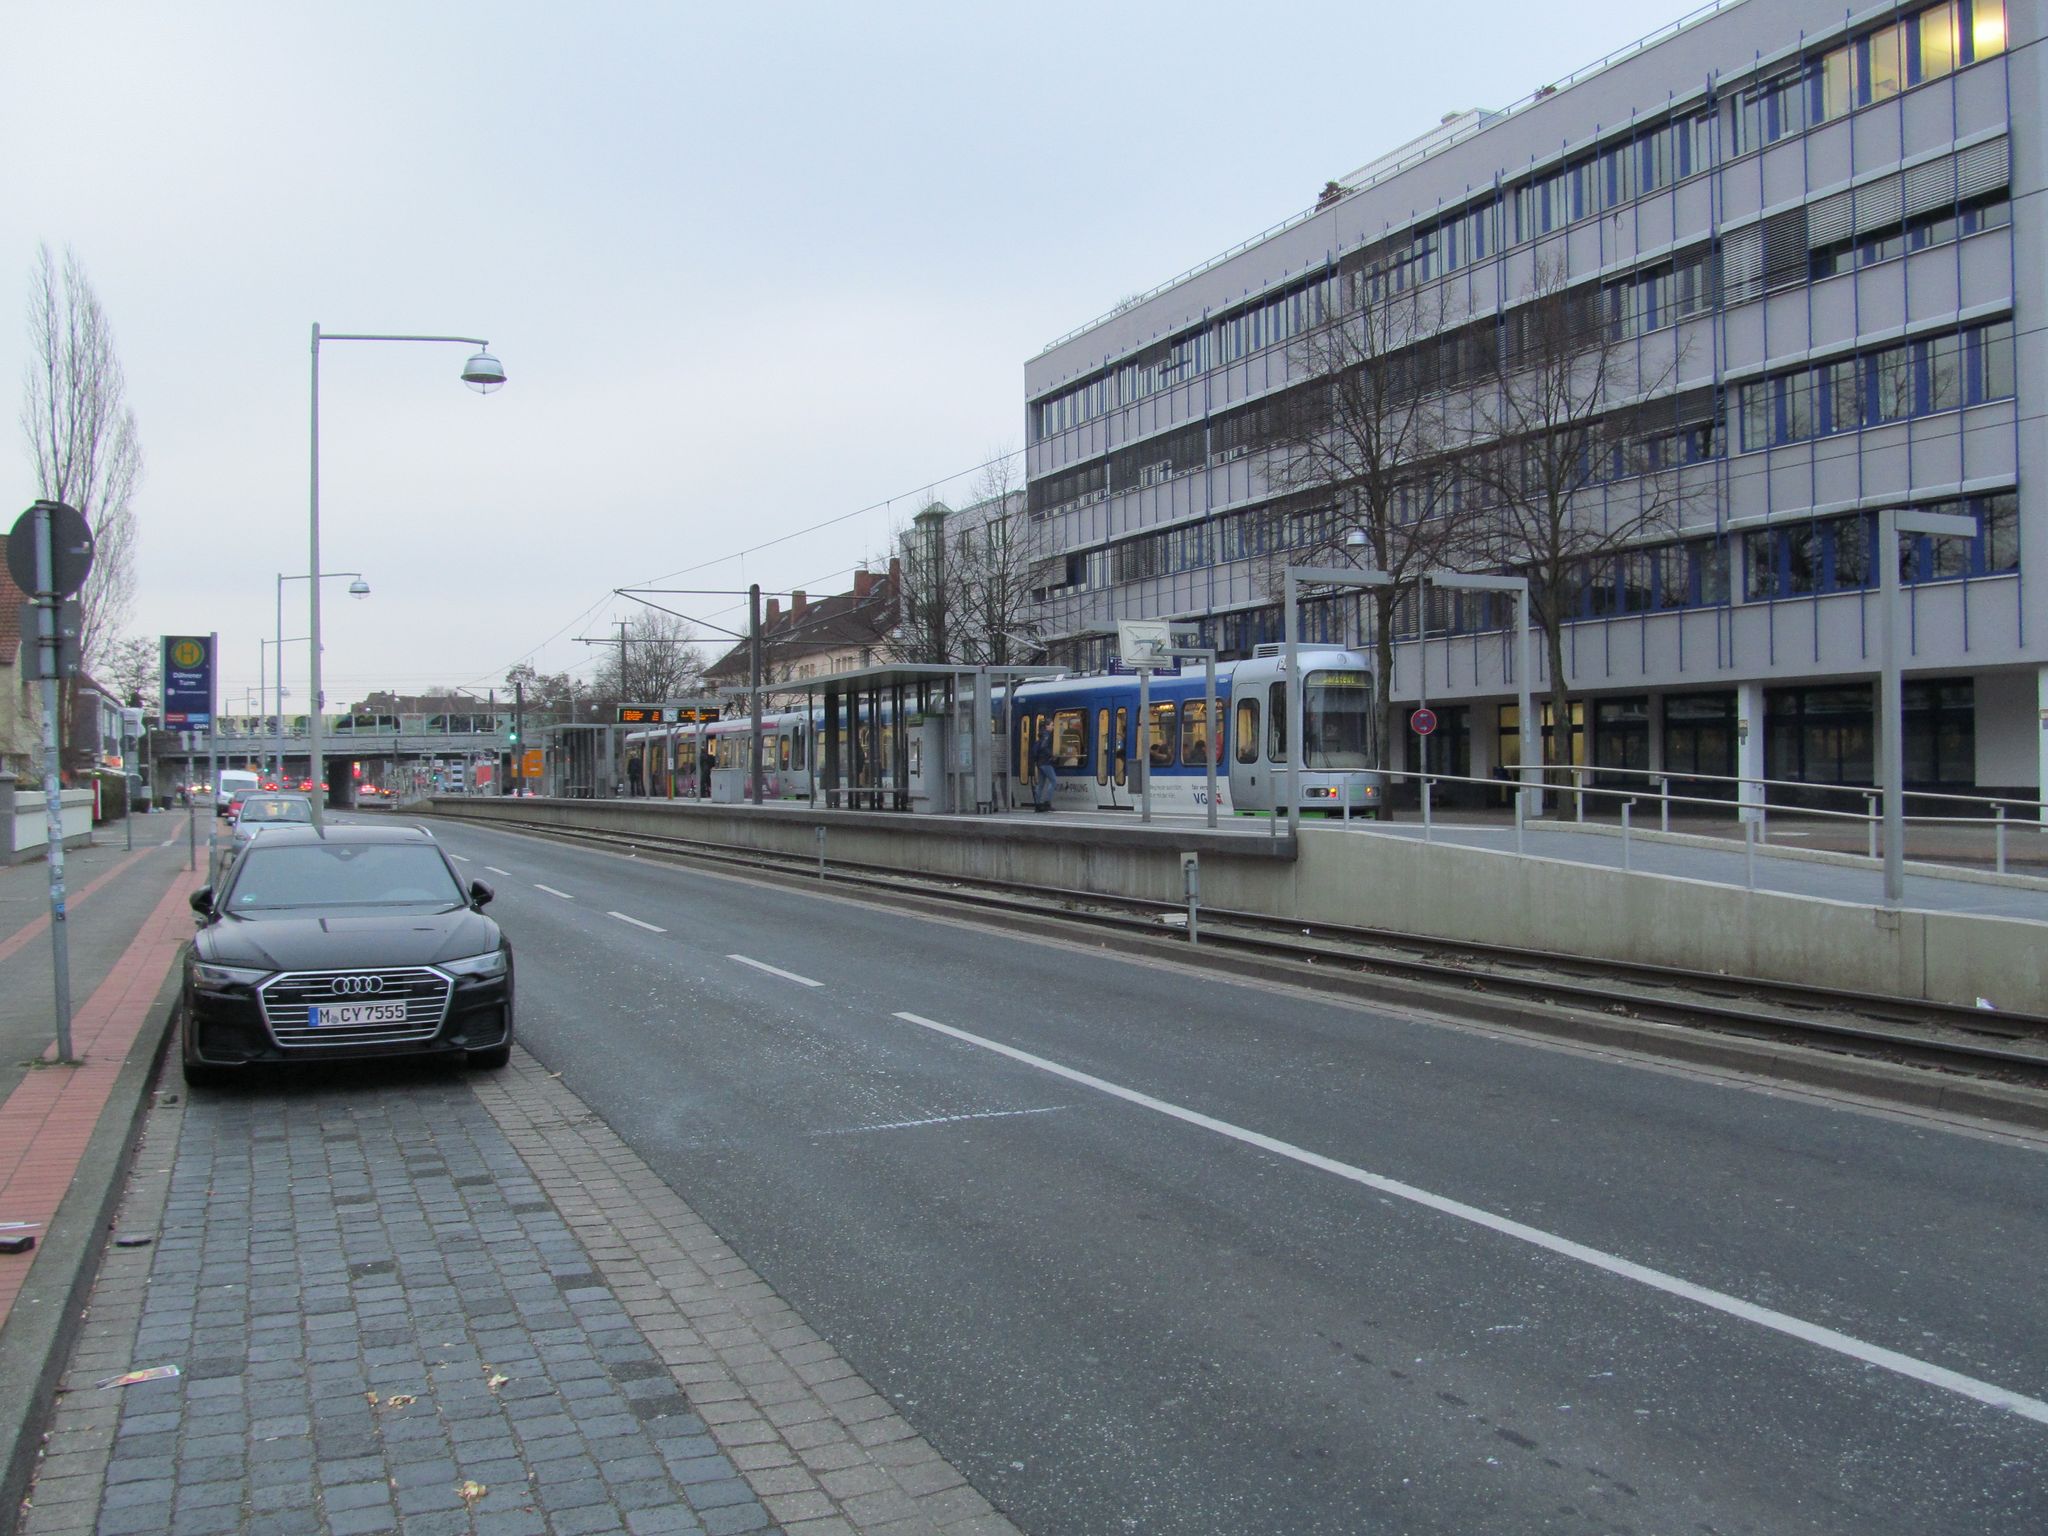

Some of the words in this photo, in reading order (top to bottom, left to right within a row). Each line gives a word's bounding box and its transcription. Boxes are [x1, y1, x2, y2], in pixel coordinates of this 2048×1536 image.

[1193, 793, 1208, 804] VG
[320, 1009, 329, 1023] M
[341, 1007, 361, 1022] CY
[365, 1005, 404, 1020] 7555
